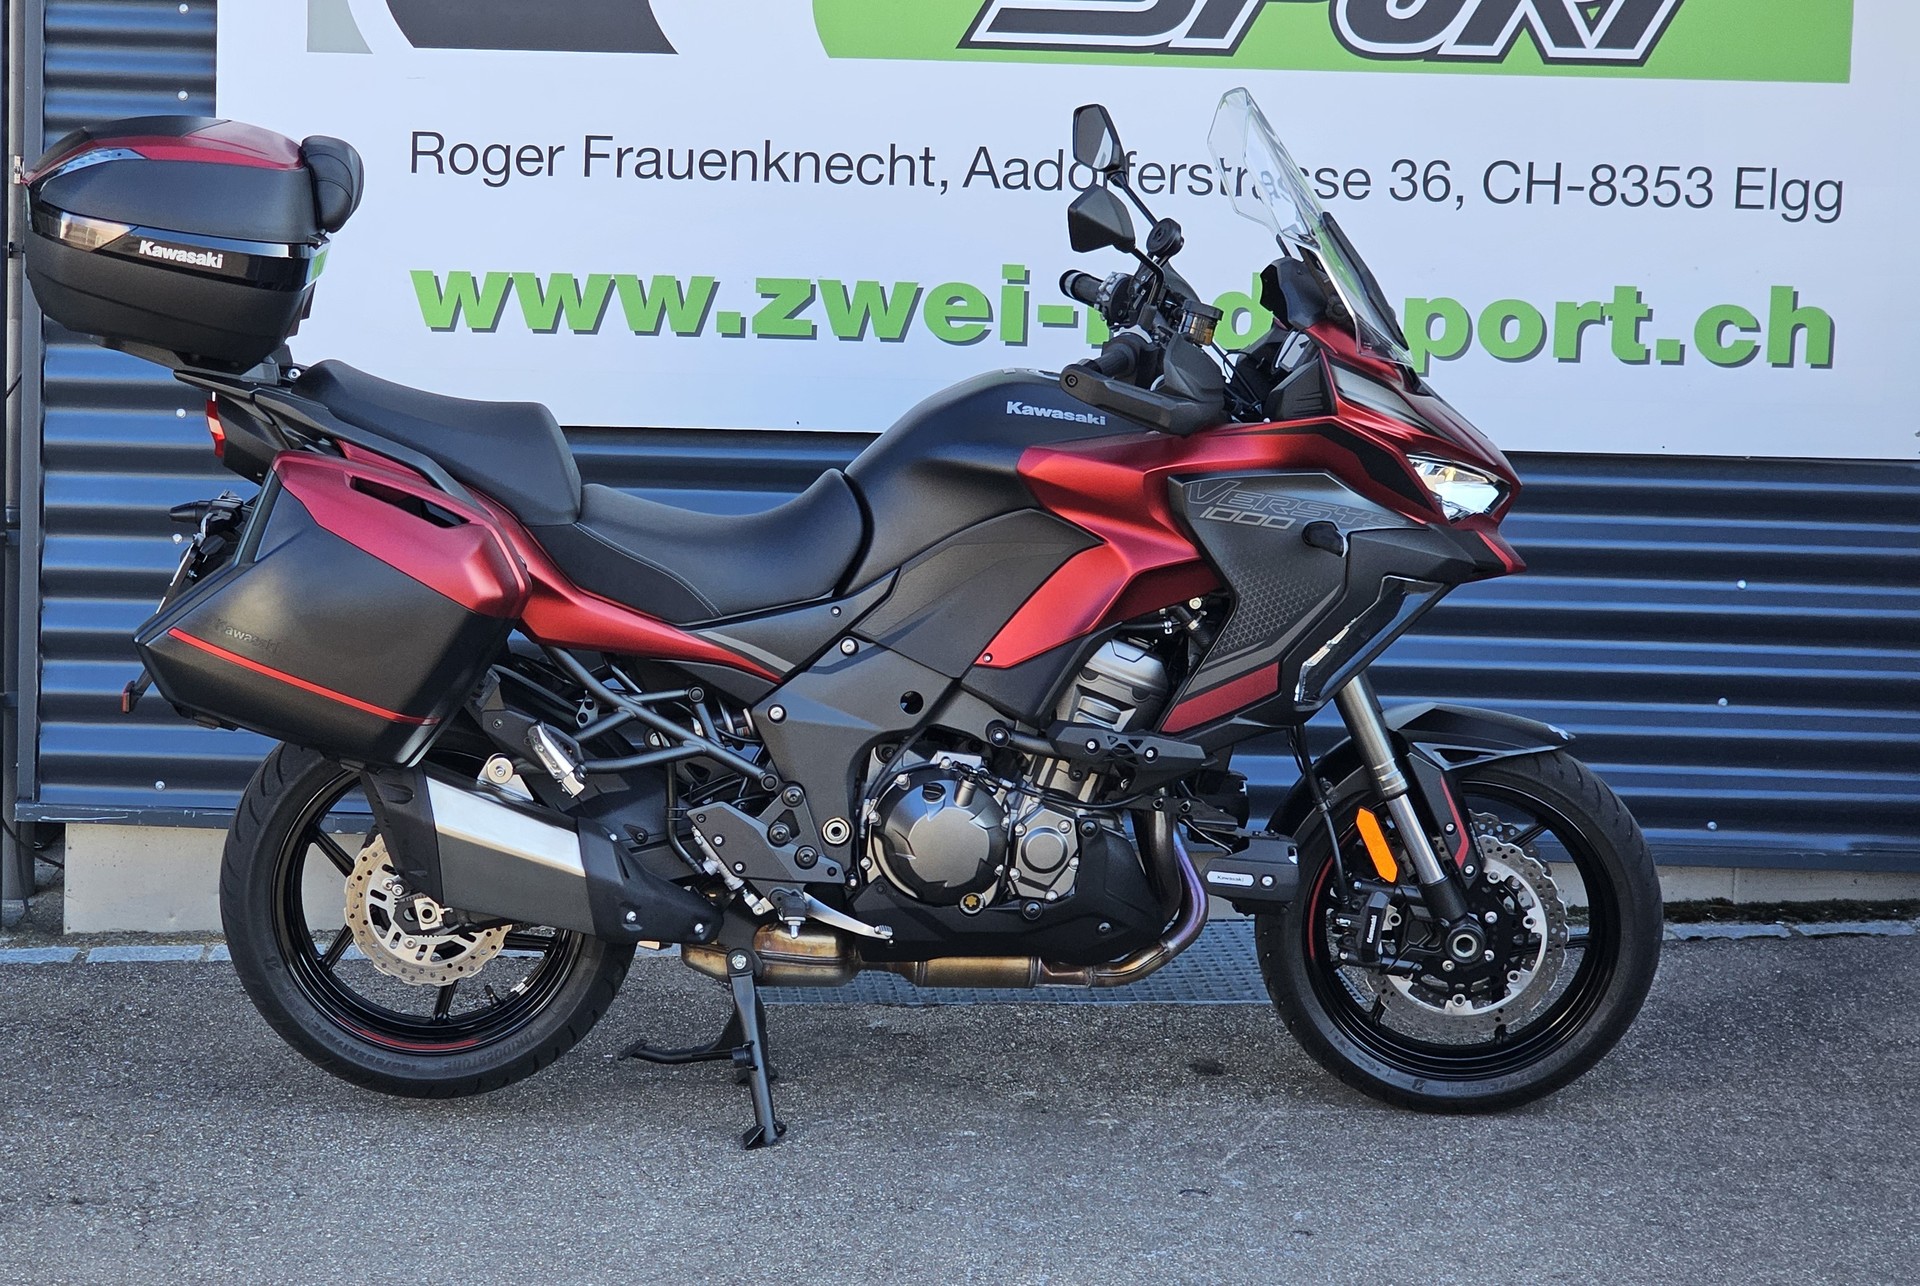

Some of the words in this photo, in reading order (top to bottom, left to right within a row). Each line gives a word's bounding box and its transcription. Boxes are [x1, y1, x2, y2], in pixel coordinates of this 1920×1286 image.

[411, 131, 565, 188] Roger
[583, 136, 948, 195] Frauenknecht,
[962, 146, 1371, 202] Aadoferstrase
[1389, 158, 1463, 211] 36,
[1483, 160, 1713, 209] CH-8353
[1735, 167, 1843, 223] Elgg
[139, 240, 223, 269] Kawasaki
[410, 264, 1836, 374] www.zwei-dport.ch
[1006, 401, 1106, 426] Kawasaki
[1200, 506, 1297, 530] 1000
